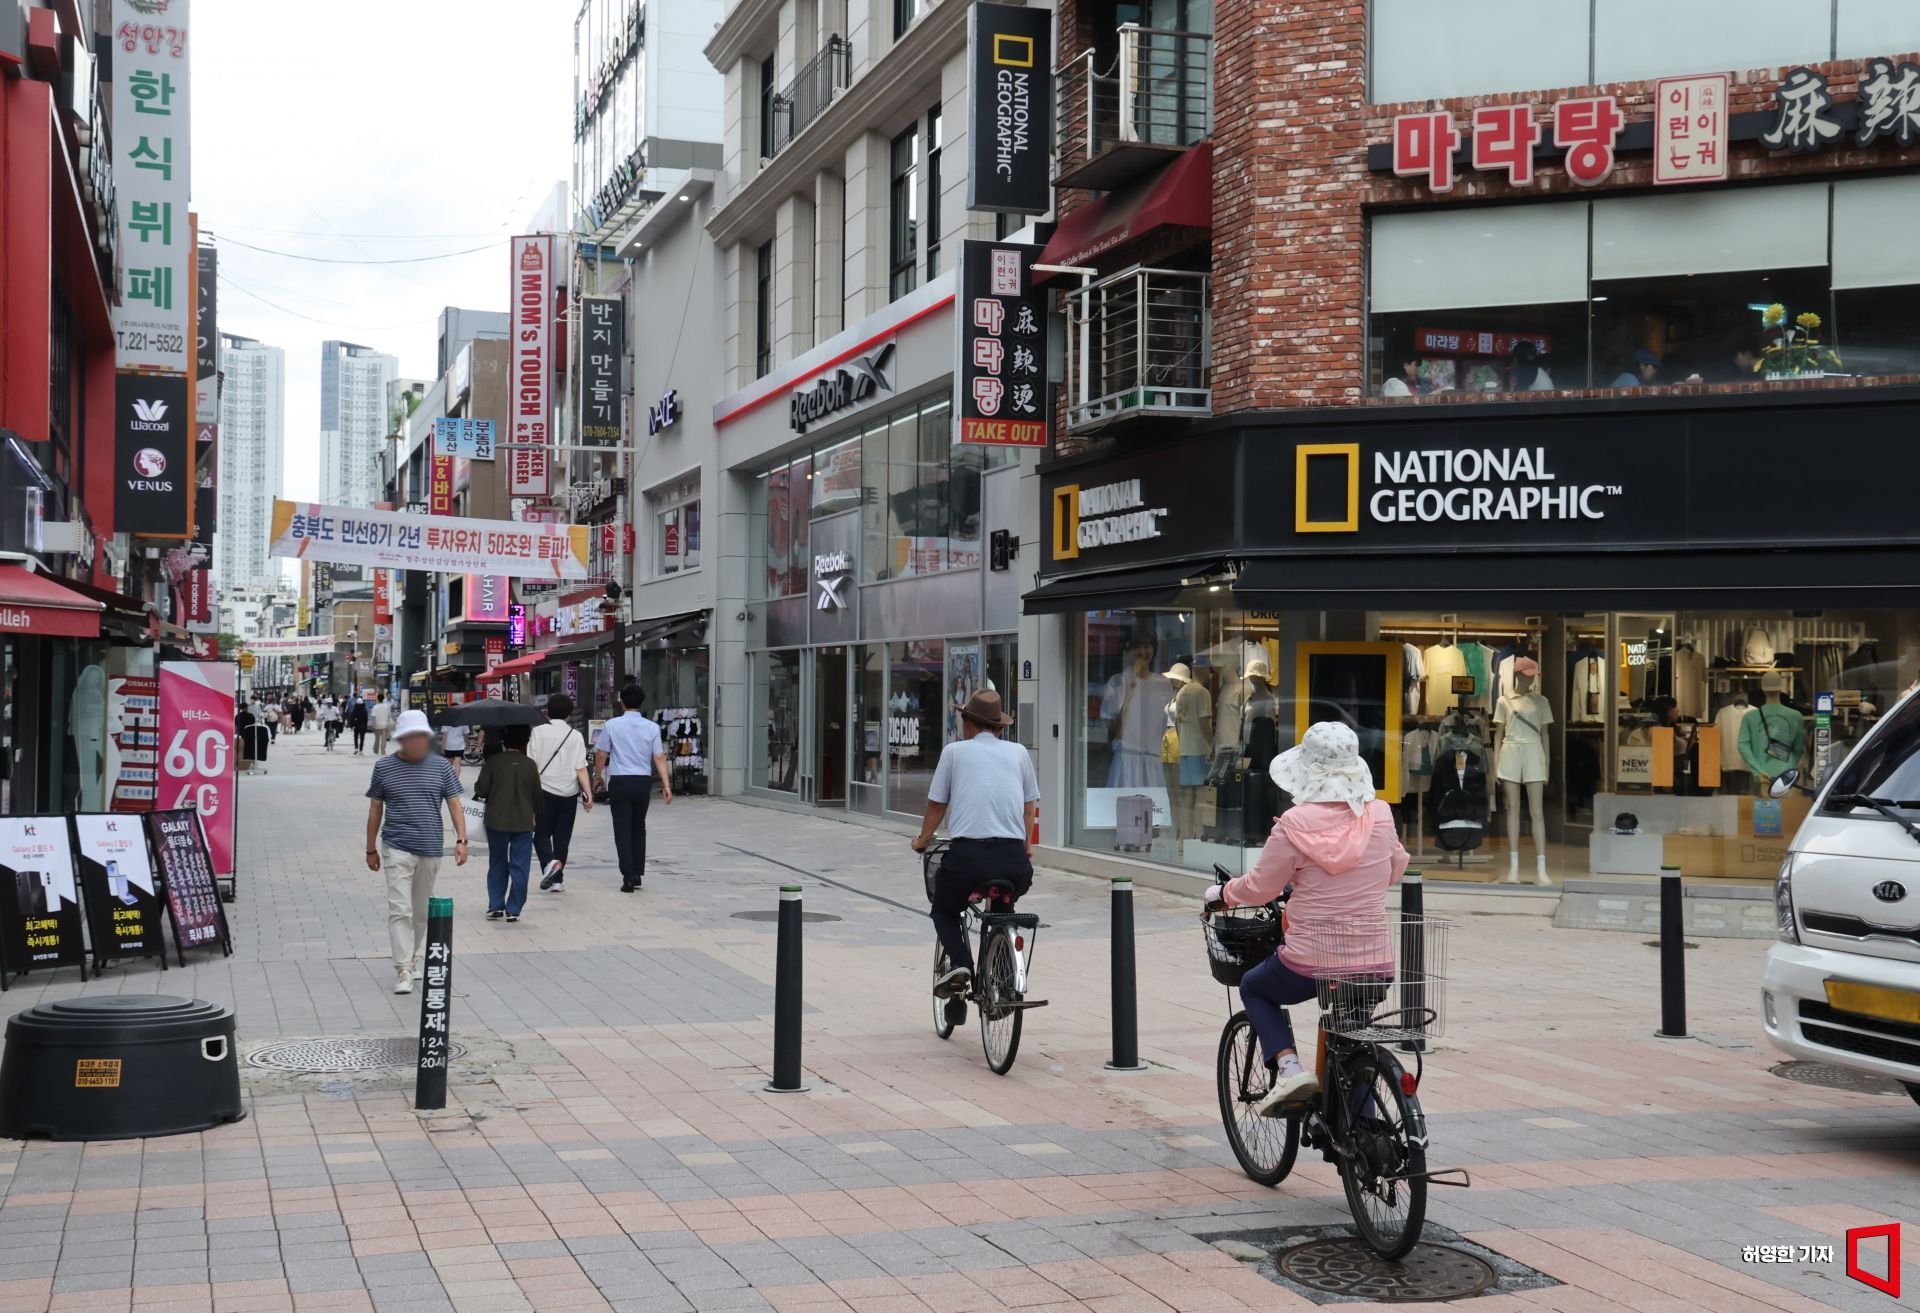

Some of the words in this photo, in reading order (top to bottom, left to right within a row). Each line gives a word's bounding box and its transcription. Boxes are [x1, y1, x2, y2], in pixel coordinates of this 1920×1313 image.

[1014, 73, 1029, 154] NATIONAL
[1393, 95, 1625, 193] 마라탕
[127, 69, 176, 310] 한식뷔페
[521, 274, 542, 342] MOM'S
[973, 298, 1005, 416] 마라탕
[1425, 334, 1460, 350] 마라탕
[520, 346, 541, 416] TOUCH
[789, 369, 855, 434] Reebok
[130, 420, 170, 432] Wacoal
[446, 421, 458, 452] 부동산
[475, 420, 491, 458] 부동산
[967, 421, 1007, 441] TAKE
[1011, 424, 1042, 442] OUT
[516, 435, 530, 485] BRGER
[1375, 447, 1555, 484] NATIONAL
[127, 480, 174, 491] VENUS
[1078, 479, 1144, 518] NATIONAL
[292, 514, 334, 541] 충북도
[341, 519, 392, 547] 민선8기
[398, 525, 420, 549] 2년
[427, 527, 482, 553] 투자유치
[487, 533, 532, 557] 50조원
[538, 535, 569, 560] 돌파!
[815, 550, 845, 578] Reebok
[191, 584, 199, 616] balance
[181, 710, 212, 721] 비너스
[888, 717, 900, 744] ZIG
[900, 717, 920, 745] CLOG
[1621, 758, 1649, 768] NEW
[24, 824, 37, 837] kt
[106, 820, 118, 832] kt
[161, 820, 190, 833] GALAXY
[1876, 883, 1900, 899] KIA
[424, 942, 450, 1033] 차량통제
